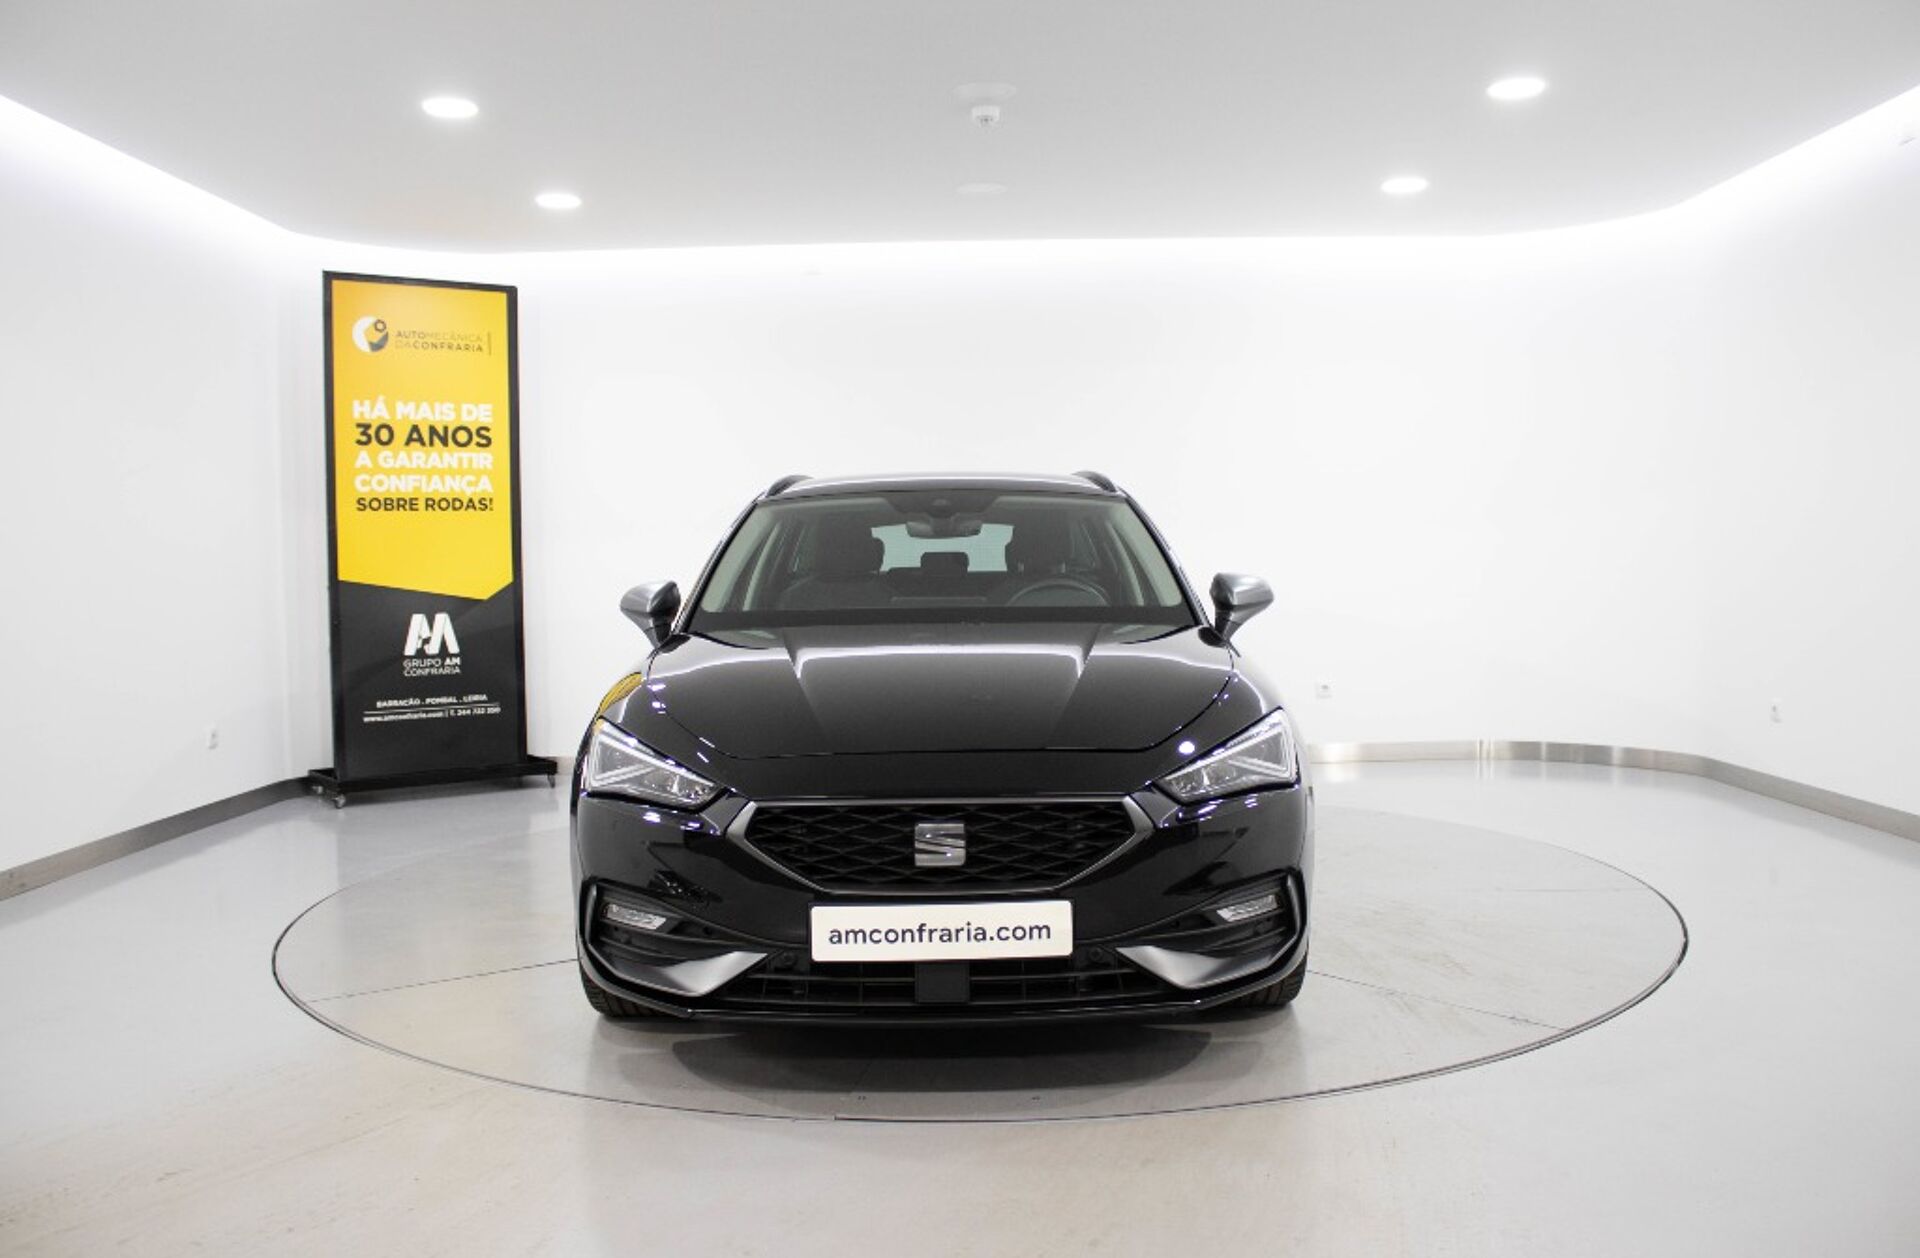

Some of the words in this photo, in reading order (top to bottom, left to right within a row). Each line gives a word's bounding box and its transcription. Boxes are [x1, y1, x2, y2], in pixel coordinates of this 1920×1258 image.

[352, 396, 390, 420] HÁ
[395, 401, 456, 421] MAIS
[461, 403, 492, 422] DE
[355, 423, 395, 447] 30
[404, 425, 492, 448] ANOS
[355, 451, 373, 469] A
[378, 452, 493, 470] GARANTIR
[354, 474, 493, 497] CONFIANÇA
[356, 497, 419, 512] SOBRE
[424, 497, 493, 512] RODAS!
[403, 658, 442, 668] GRUPO
[444, 656, 461, 666] AM
[404, 666, 461, 677] CONFRARIA
[828, 921, 1052, 945] amconfraria.com
